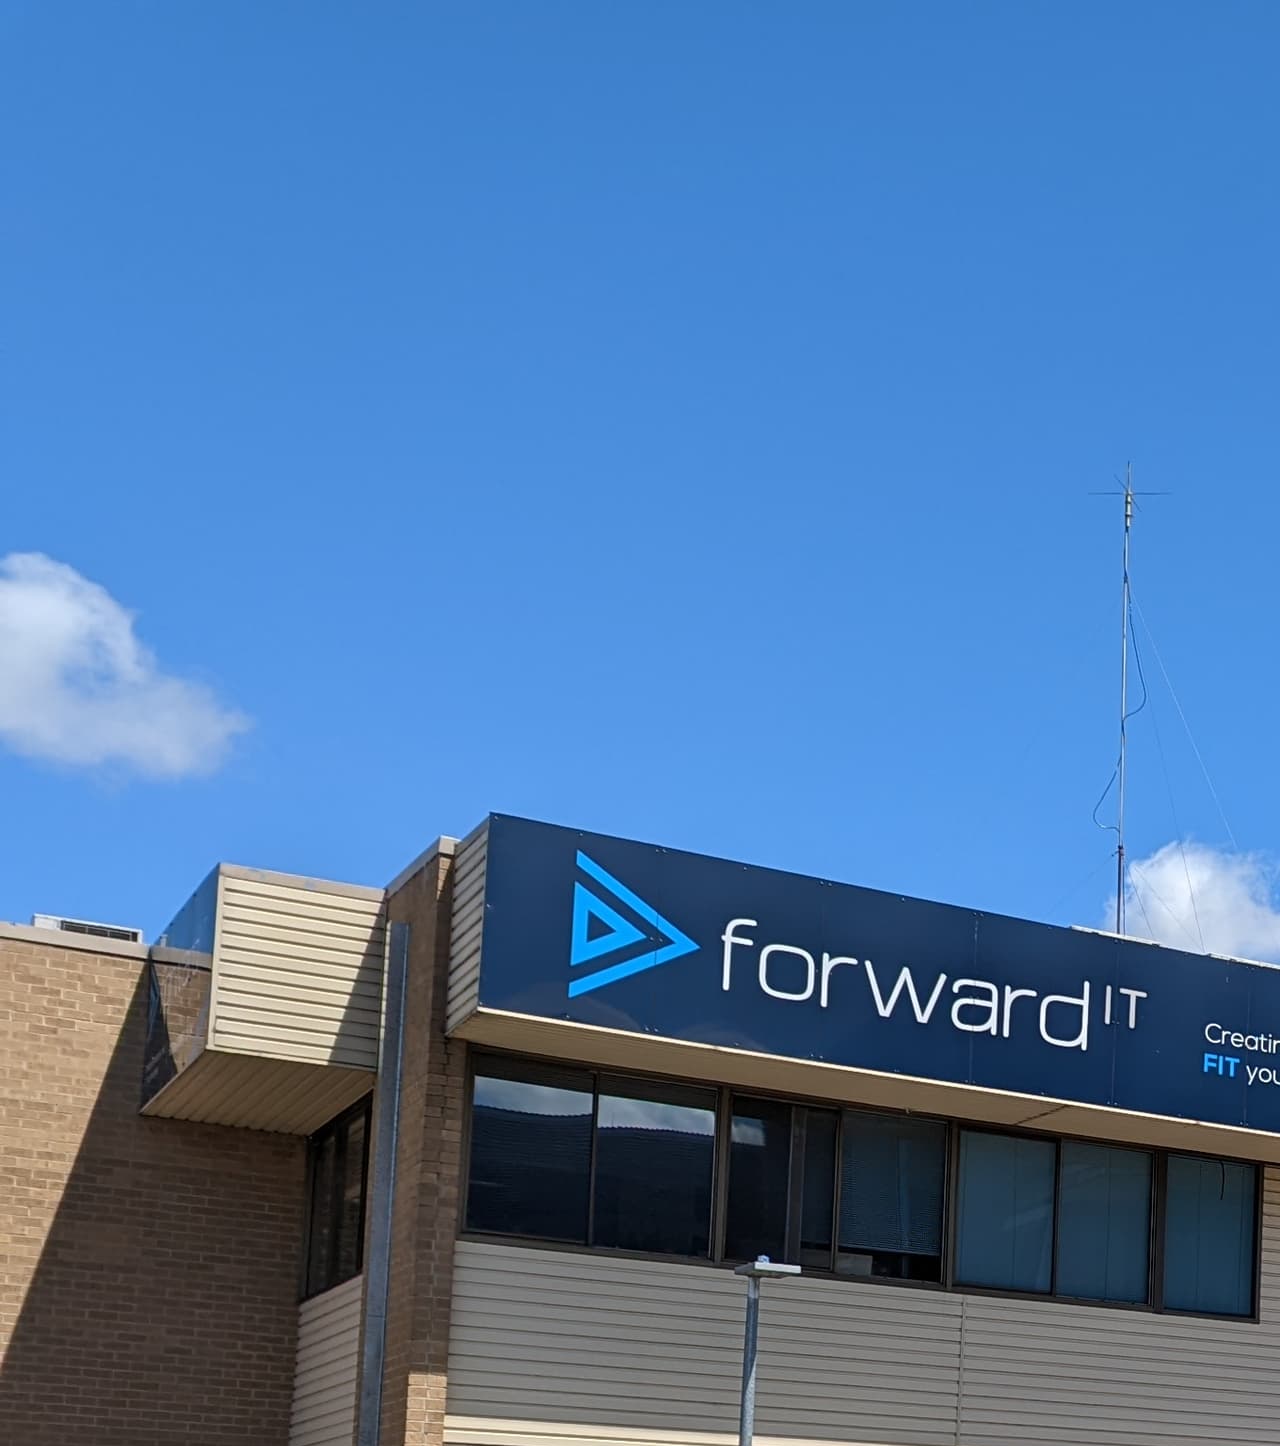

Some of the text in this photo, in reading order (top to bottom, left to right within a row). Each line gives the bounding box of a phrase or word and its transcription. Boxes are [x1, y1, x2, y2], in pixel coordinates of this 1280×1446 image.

[721, 918, 1148, 1052] forward IT
[1203, 1053, 1240, 1078] FIT
